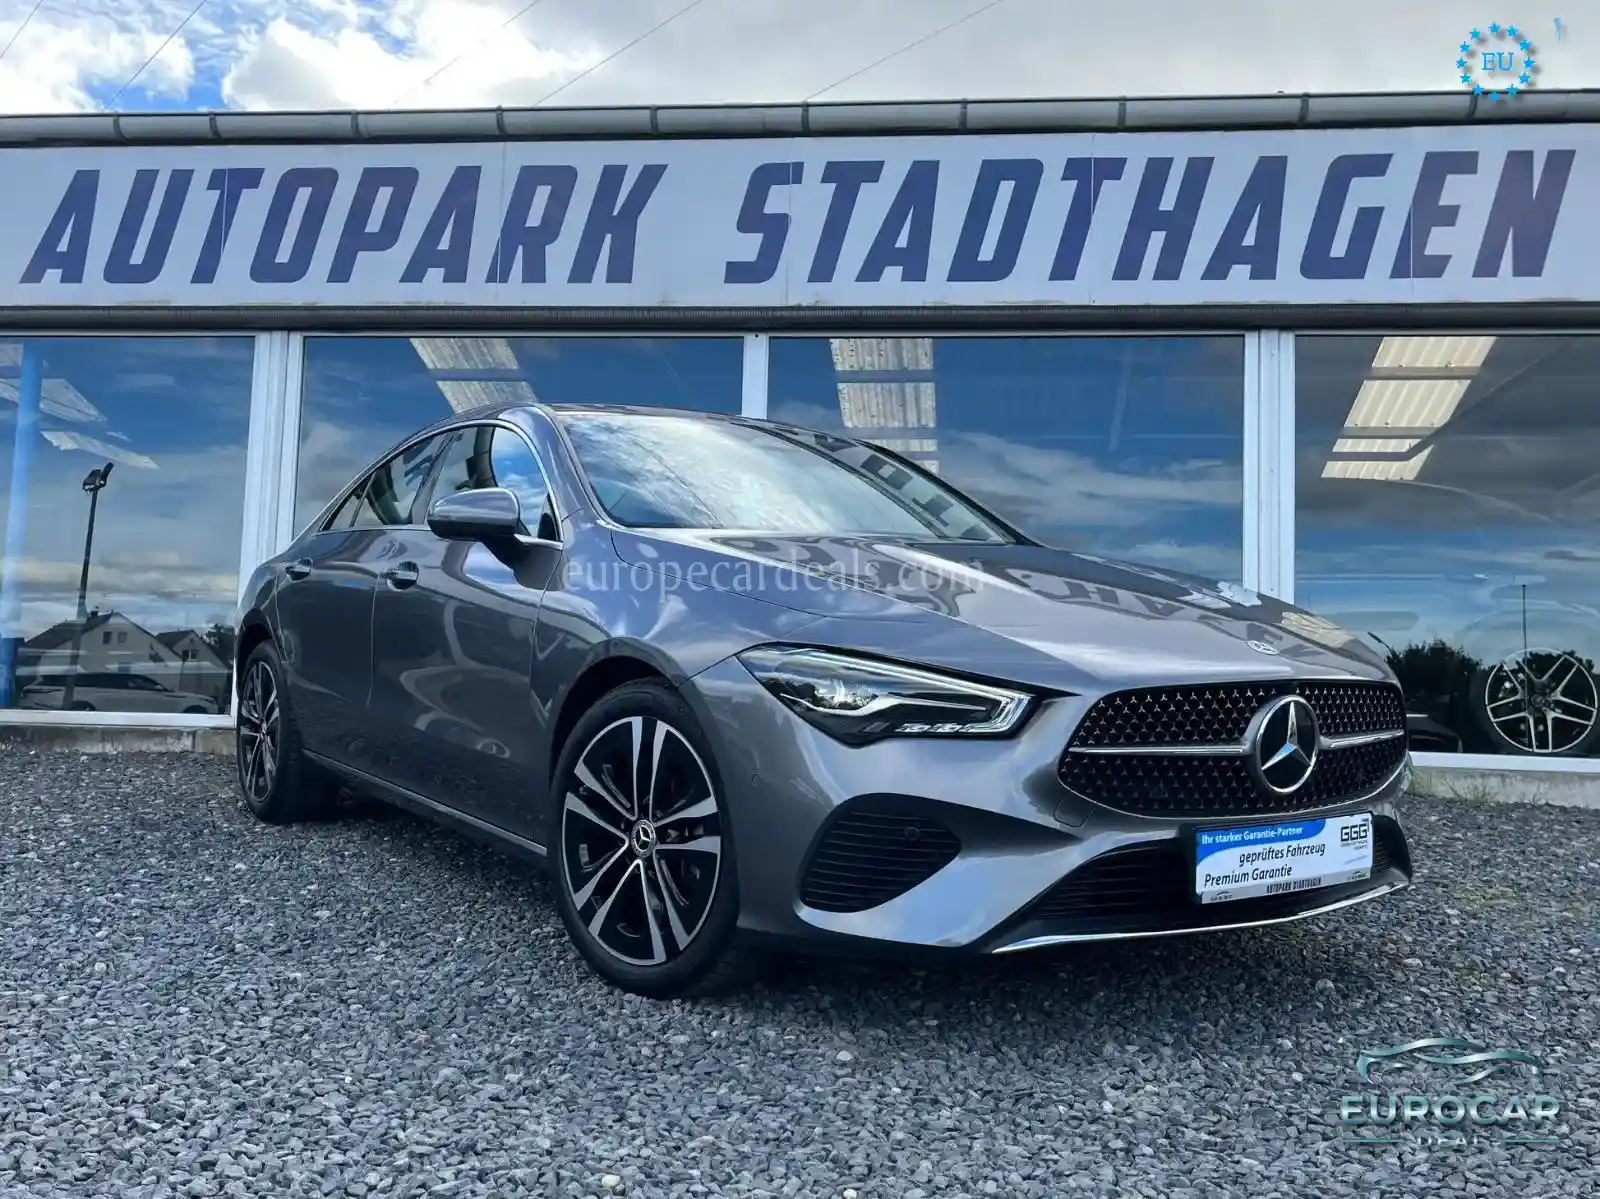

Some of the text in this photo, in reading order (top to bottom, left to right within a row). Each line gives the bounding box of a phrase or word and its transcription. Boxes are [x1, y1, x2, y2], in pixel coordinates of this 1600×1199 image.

[19, 148, 1577, 285] AUTOPARK STADTHAGEN
[1201, 826, 1304, 844] Ihr starker Garantie-Partner
[1239, 846, 1285, 867] geprüftes
[1285, 842, 1326, 858] Fahrzeug
[1204, 863, 1293, 888] Premium Garantie
